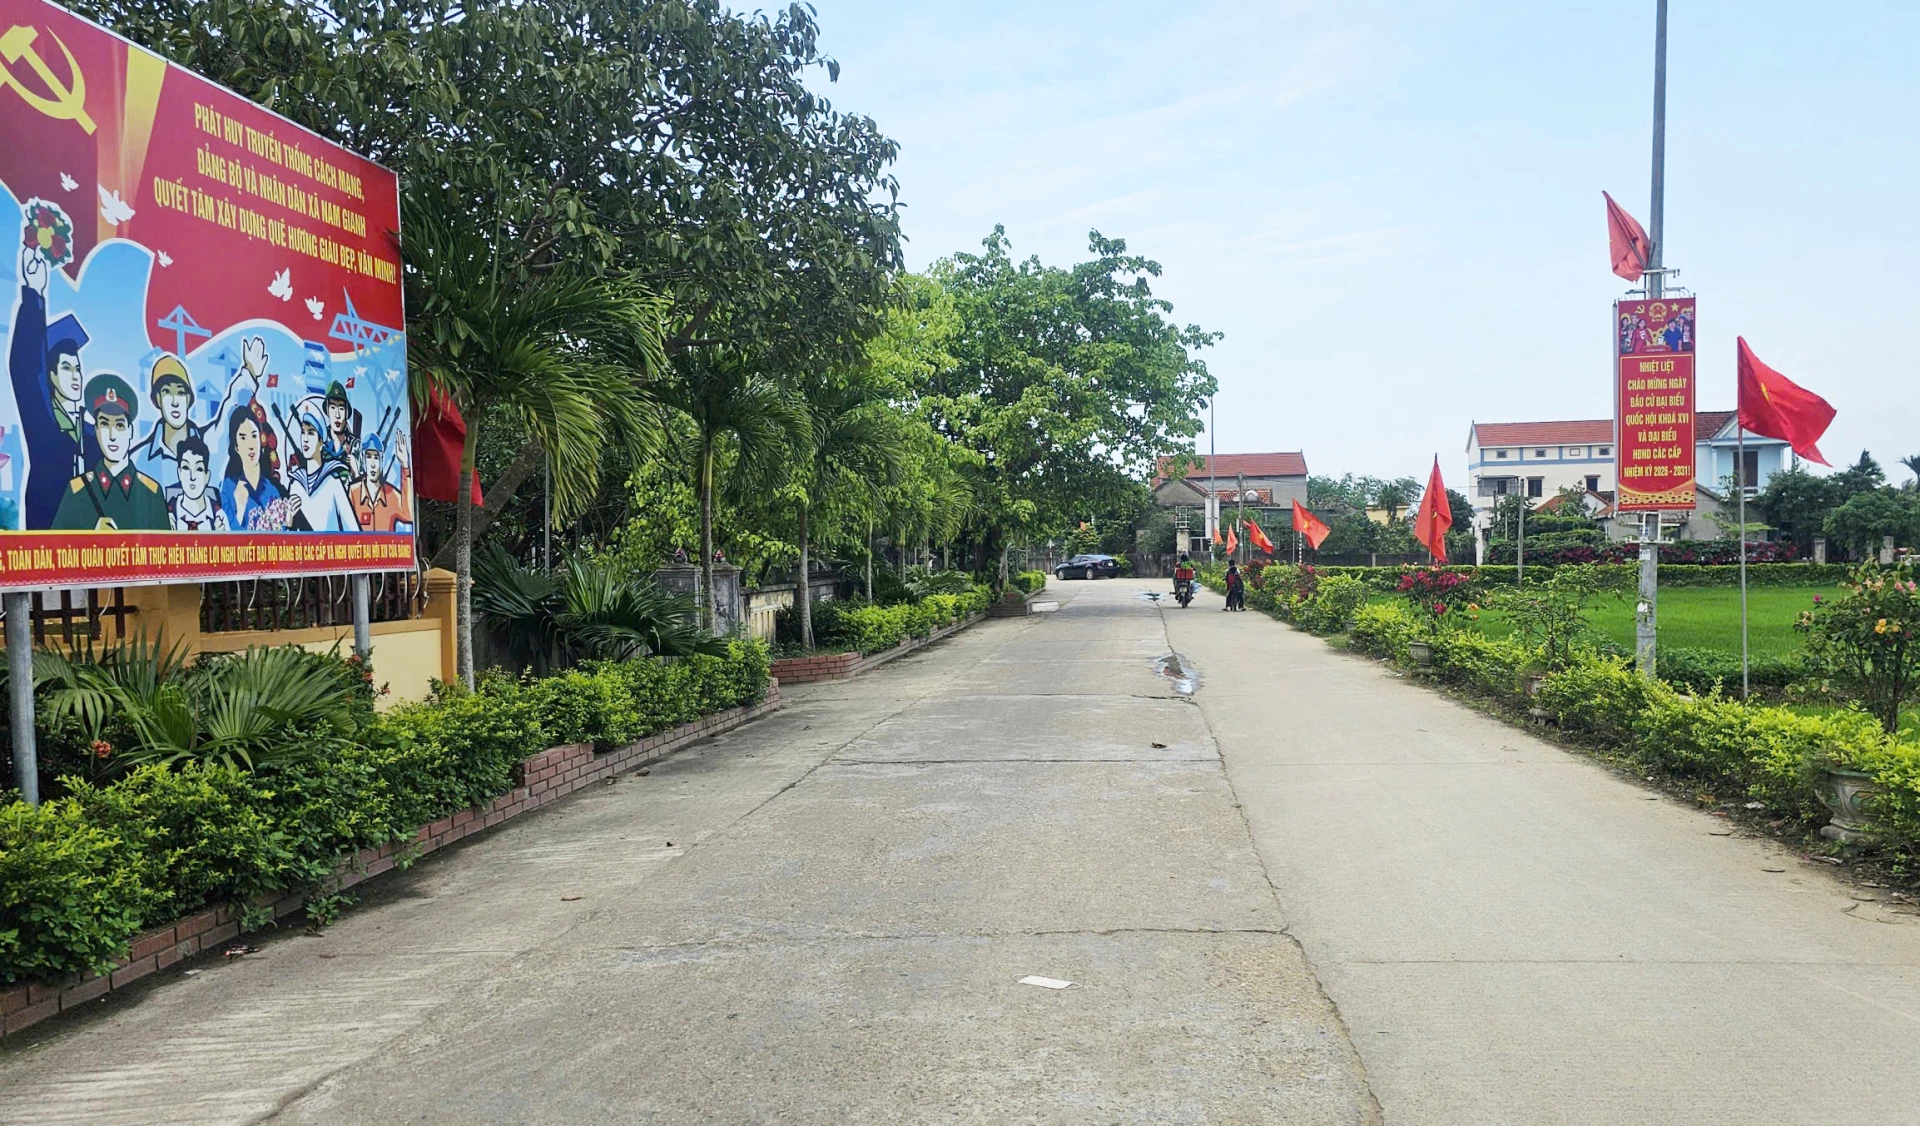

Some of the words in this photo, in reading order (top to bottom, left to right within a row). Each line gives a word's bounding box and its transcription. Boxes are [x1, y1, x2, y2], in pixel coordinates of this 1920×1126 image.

[194, 102, 222, 138] PHÁT
[223, 116, 243, 148] HUY
[245, 126, 282, 165] TRUYỀN
[283, 142, 313, 178] THỐNG
[314, 156, 337, 189] CÁCH
[338, 169, 364, 203] MẠNG,
[197, 142, 227, 183] ĐẢNG
[228, 159, 243, 194] BỘ
[244, 165, 258, 196] VÀ
[259, 173, 286, 206] NHÂN
[287, 183, 306, 214] DÂN
[308, 192, 320, 220] XÃ
[321, 199, 341, 228] NAM
[342, 208, 366, 238] GIANH
[154, 176, 188, 213] QUYẾT
[191, 187, 215, 222] TÂM
[216, 197, 237, 230] XÂY
[239, 207, 266, 240] DỰNG
[268, 218, 287, 247] QUÊ
[288, 226, 318, 258] HƯƠNG
[319, 236, 339, 265] GIÀU
[340, 245, 357, 273] ĐẸP,
[357, 250, 374, 277] VĂN
[374, 257, 396, 284] MINH!
[1640, 359, 1659, 374] NHIỆT
[1660, 359, 1674, 373] LIỆT
[1627, 377, 1645, 390] CHÀO
[1647, 377, 1667, 390] MỪNG
[1668, 376, 1687, 389] NGÀY
[1645, 393, 1655, 407] CỬ
[1656, 396, 1667, 409] ĐẠI
[1625, 410, 1643, 426] QUỐC
[1645, 411, 1656, 426] HỘI
[1658, 411, 1676, 424] KHOÁ
[1678, 412, 1689, 424] XVI
[1638, 429, 1647, 442] VÀ
[1648, 431, 1660, 444] ĐẠI
[1652, 446, 1666, 459] CÁC
[1668, 444, 1682, 458] CẤP
[1624, 464, 1643, 479] NHIỆM
[1644, 464, 1653, 476] KỲ
[1653, 465, 1668, 477] 2026
[1673, 465, 1691, 477] 2031!
[7, 545, 31, 571] TOÀN
[34, 545, 55, 571] DÂN,
[57, 544, 79, 568] TOÀN
[81, 544, 104, 570] QUÂN
[106, 541, 130, 568] QUYẾT
[131, 543, 147, 565] TÂM
[148, 545, 166, 569] THỰC
[168, 543, 185, 568] HIỆN
[186, 540, 208, 564] THẮNG
[209, 545, 220, 567] LỢI
[220, 546, 236, 566] NGHỊ
[237, 540, 256, 564] QUYẾT
[256, 545, 267, 565] ĐẠI
[267, 542, 278, 565] HỘI
[303, 542, 315, 561] CÁC
[315, 540, 326, 561] CẤP
[327, 541, 334, 560] VÀ
